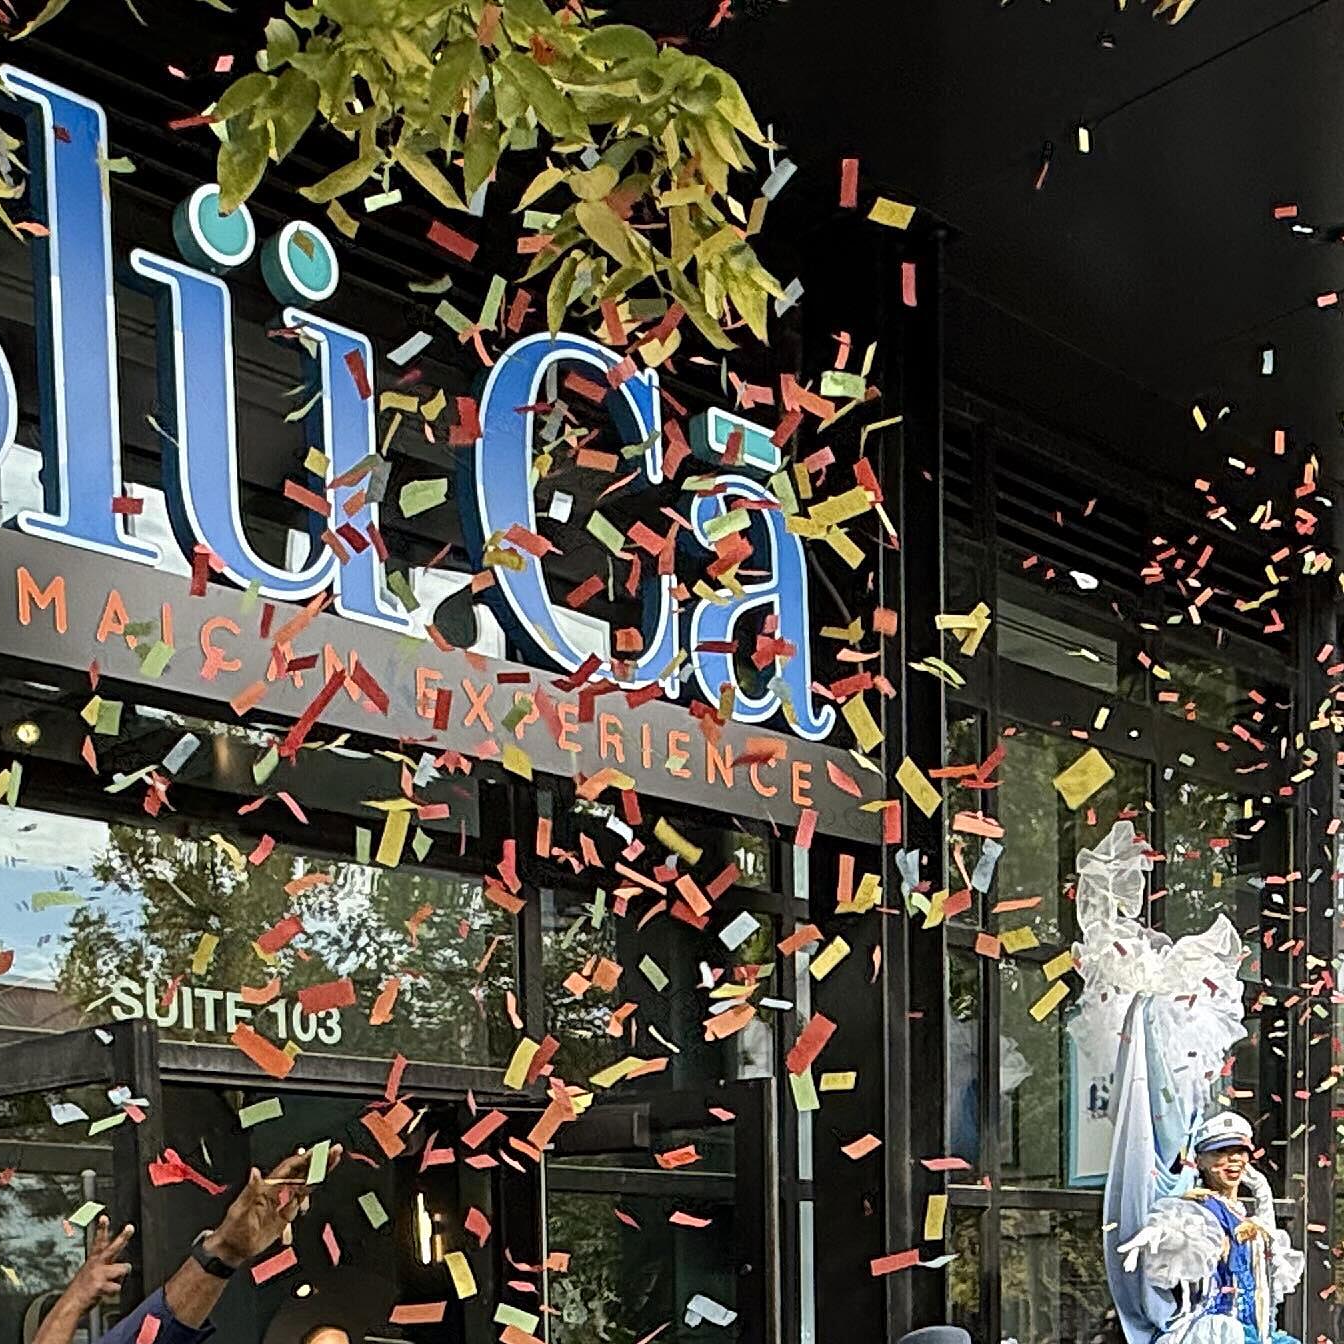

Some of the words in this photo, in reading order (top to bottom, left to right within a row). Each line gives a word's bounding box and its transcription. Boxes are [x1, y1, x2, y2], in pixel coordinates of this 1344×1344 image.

[414, 666, 813, 808] EXPERIENCE
[111, 976, 253, 1033] SUITE
[268, 998, 343, 1045] 103
